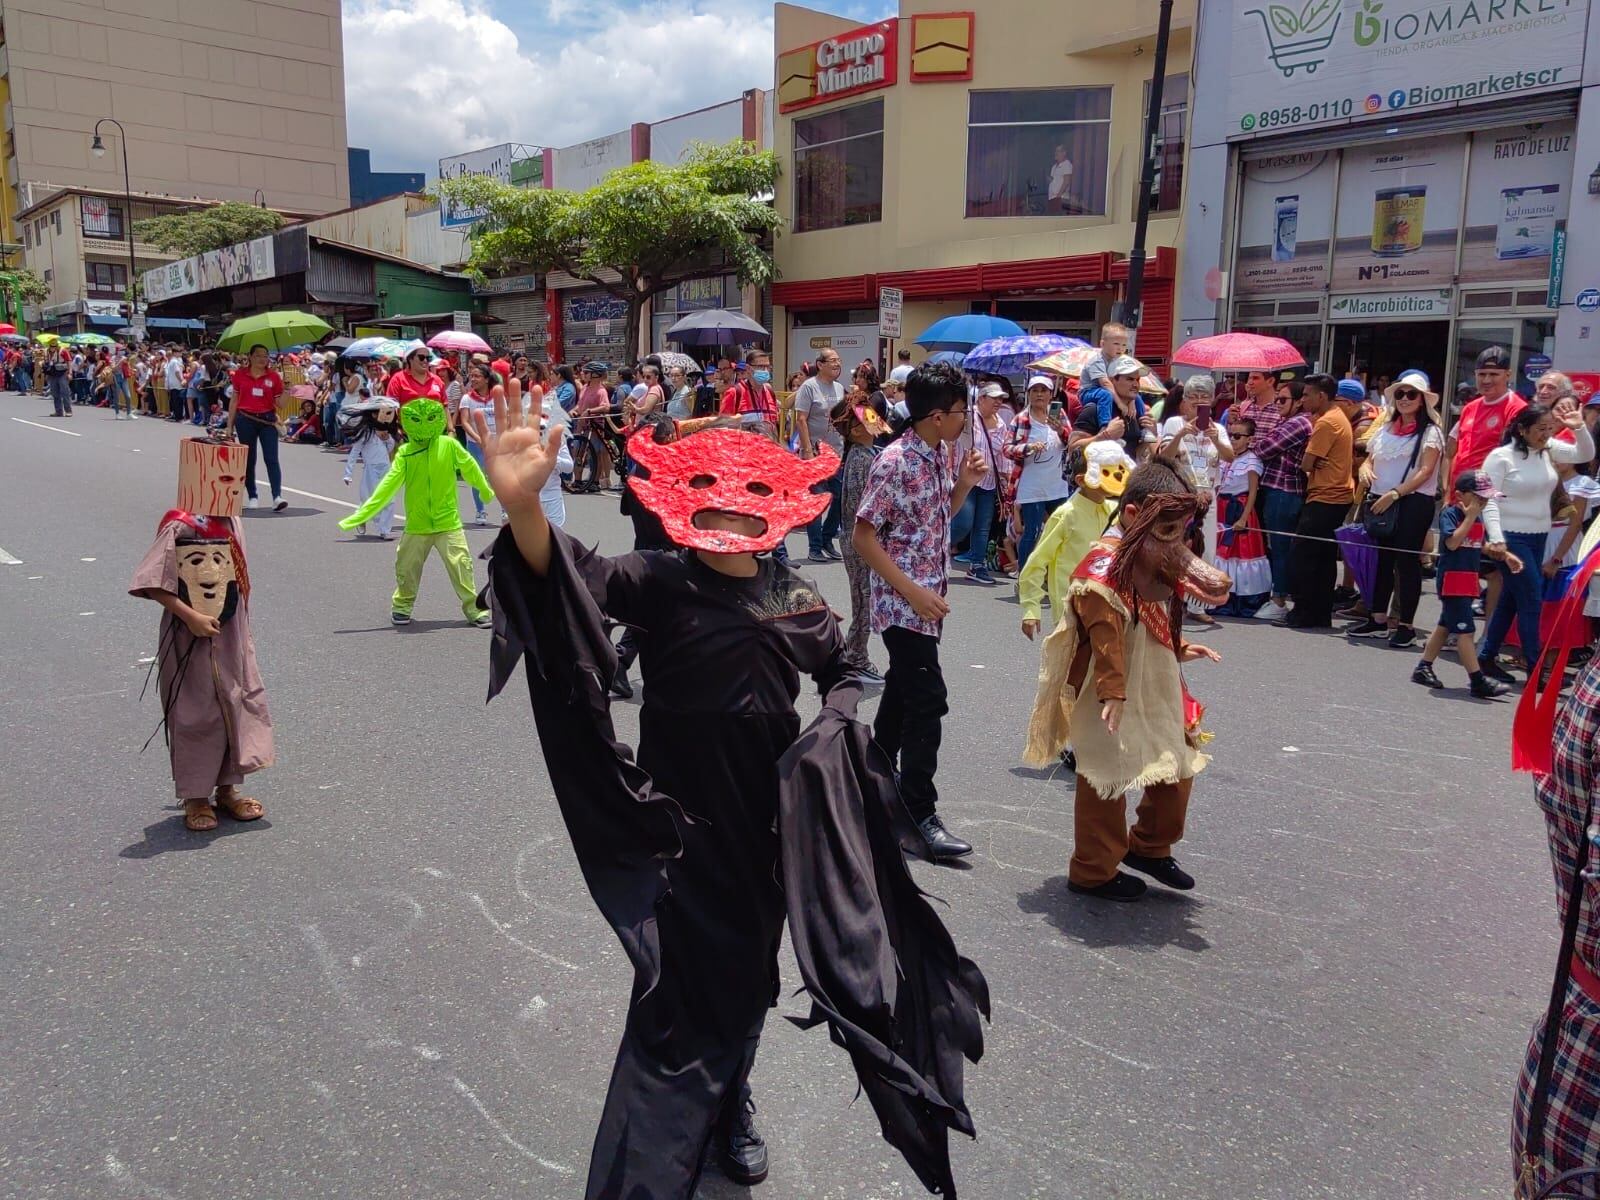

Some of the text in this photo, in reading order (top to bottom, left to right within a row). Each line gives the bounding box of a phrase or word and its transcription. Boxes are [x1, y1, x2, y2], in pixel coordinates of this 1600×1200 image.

[817, 33, 885, 67] Grupo
[816, 55, 885, 96] Mutual
[1259, 66, 1563, 128] 8958-0110 Biomarketscr
[1494, 141, 1526, 160] RAYO
[1528, 138, 1545, 156] DE
[1548, 135, 1571, 153] LUZ
[1348, 294, 1433, 314] Macrobiótica
[1579, 295, 1600, 306] ADT
